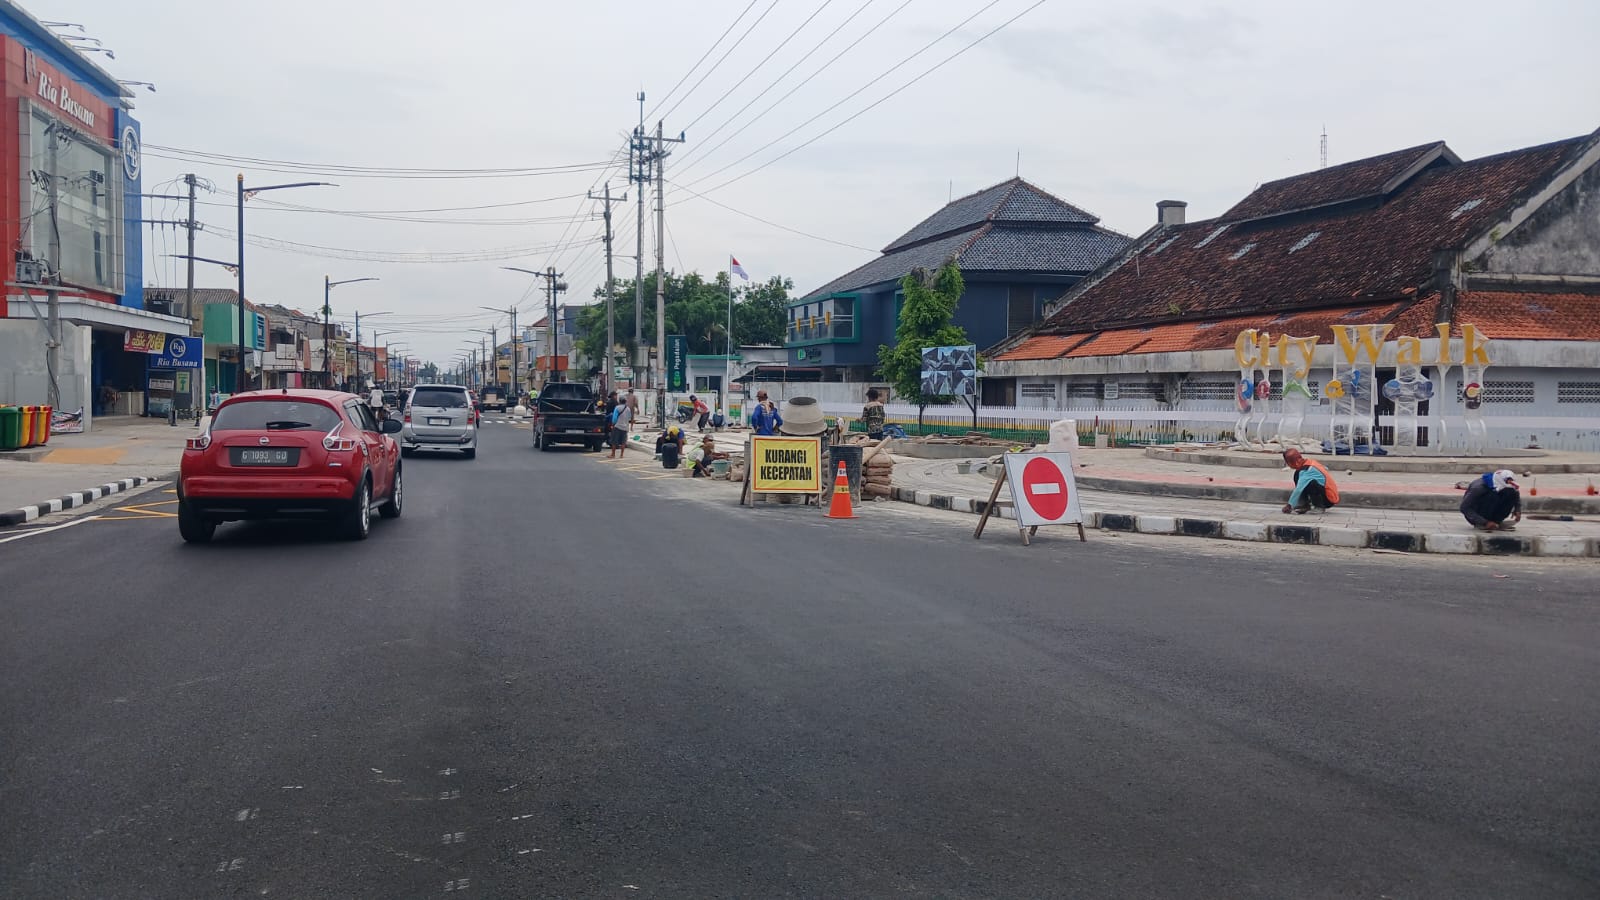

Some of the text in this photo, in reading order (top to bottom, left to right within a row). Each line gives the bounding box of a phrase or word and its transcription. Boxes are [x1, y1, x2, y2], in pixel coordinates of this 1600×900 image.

[38, 71, 95, 128] Ria Busana
[1235, 323, 1492, 379] City Walk
[157, 358, 198, 367] Ria Busana
[242, 450, 248, 460] G
[252, 450, 269, 460] 1093
[765, 449, 807, 464] KURANGI
[760, 465, 812, 480] KECEPATAN
